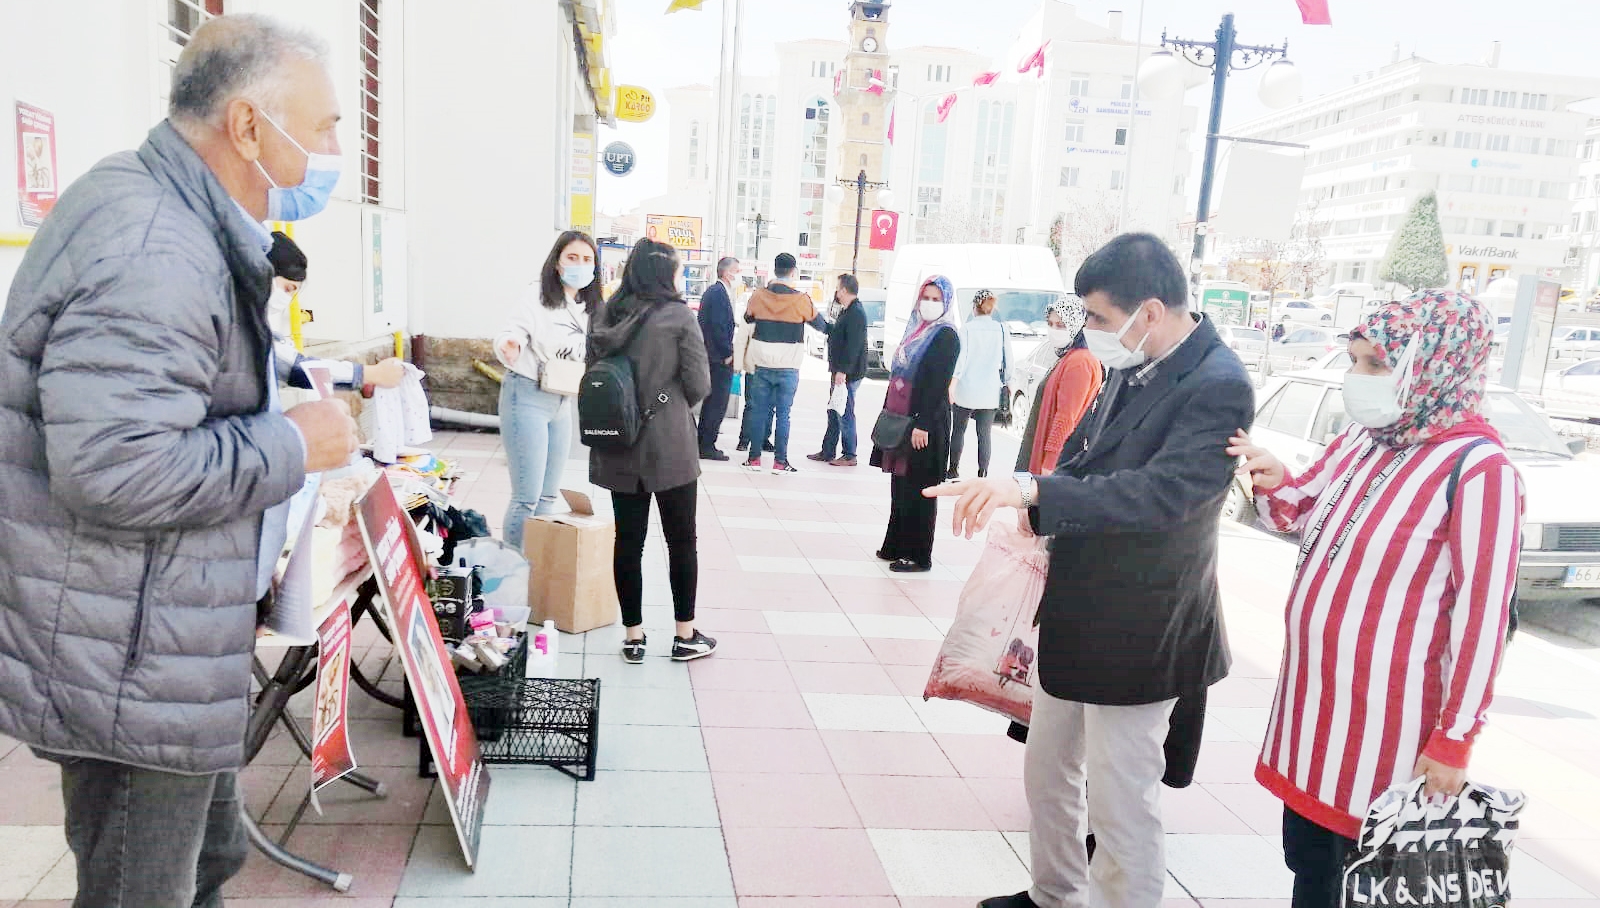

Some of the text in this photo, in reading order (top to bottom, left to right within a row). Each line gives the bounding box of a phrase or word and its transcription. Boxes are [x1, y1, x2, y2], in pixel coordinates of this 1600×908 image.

[1519, 119, 1547, 129] KURSU
[606, 152, 632, 164] UPT
[1575, 568, 1592, 581] 66
[1395, 876, 1420, 906] &
